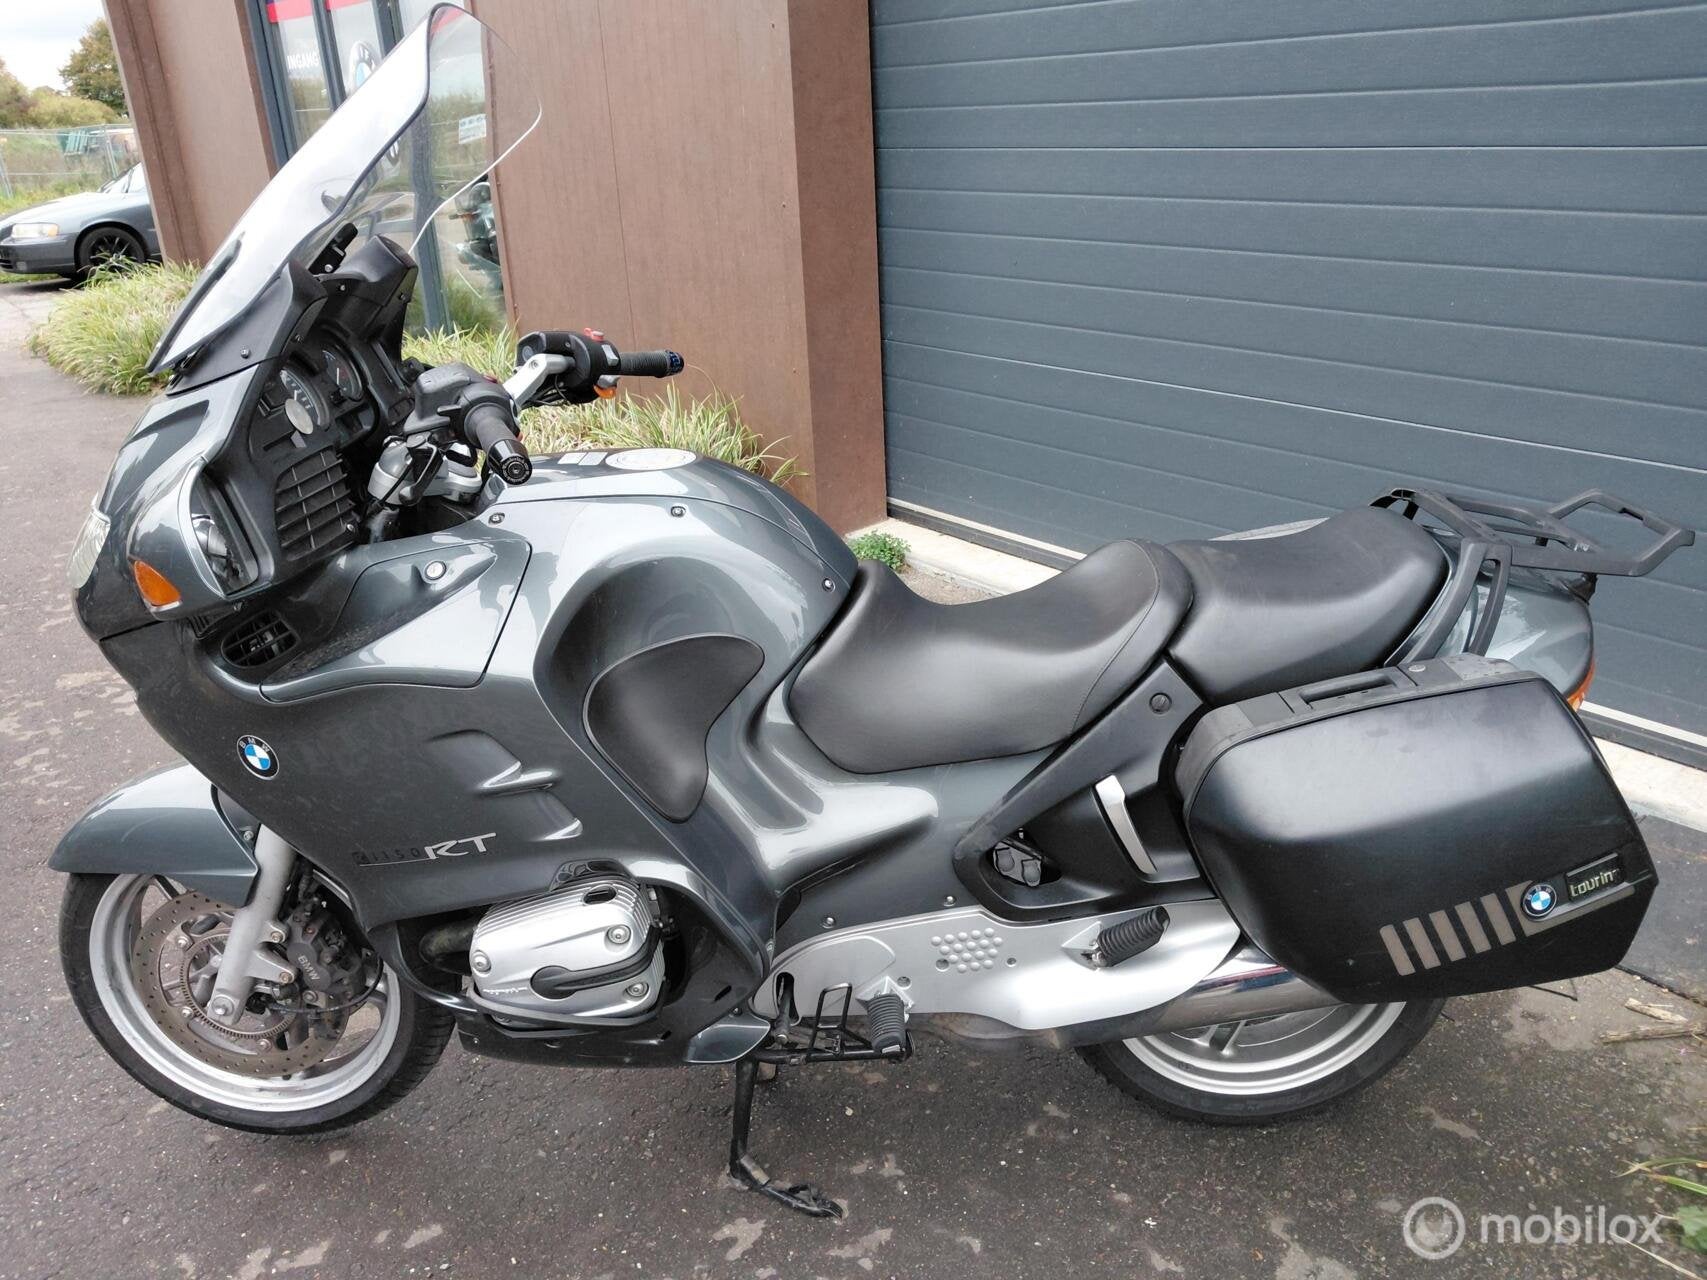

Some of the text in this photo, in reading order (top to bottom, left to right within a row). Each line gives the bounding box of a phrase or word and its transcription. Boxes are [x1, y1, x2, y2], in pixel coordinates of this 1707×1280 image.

[239, 737, 270, 752] BMW
[424, 832, 497, 860] RT
[298, 955, 320, 980] BMW
